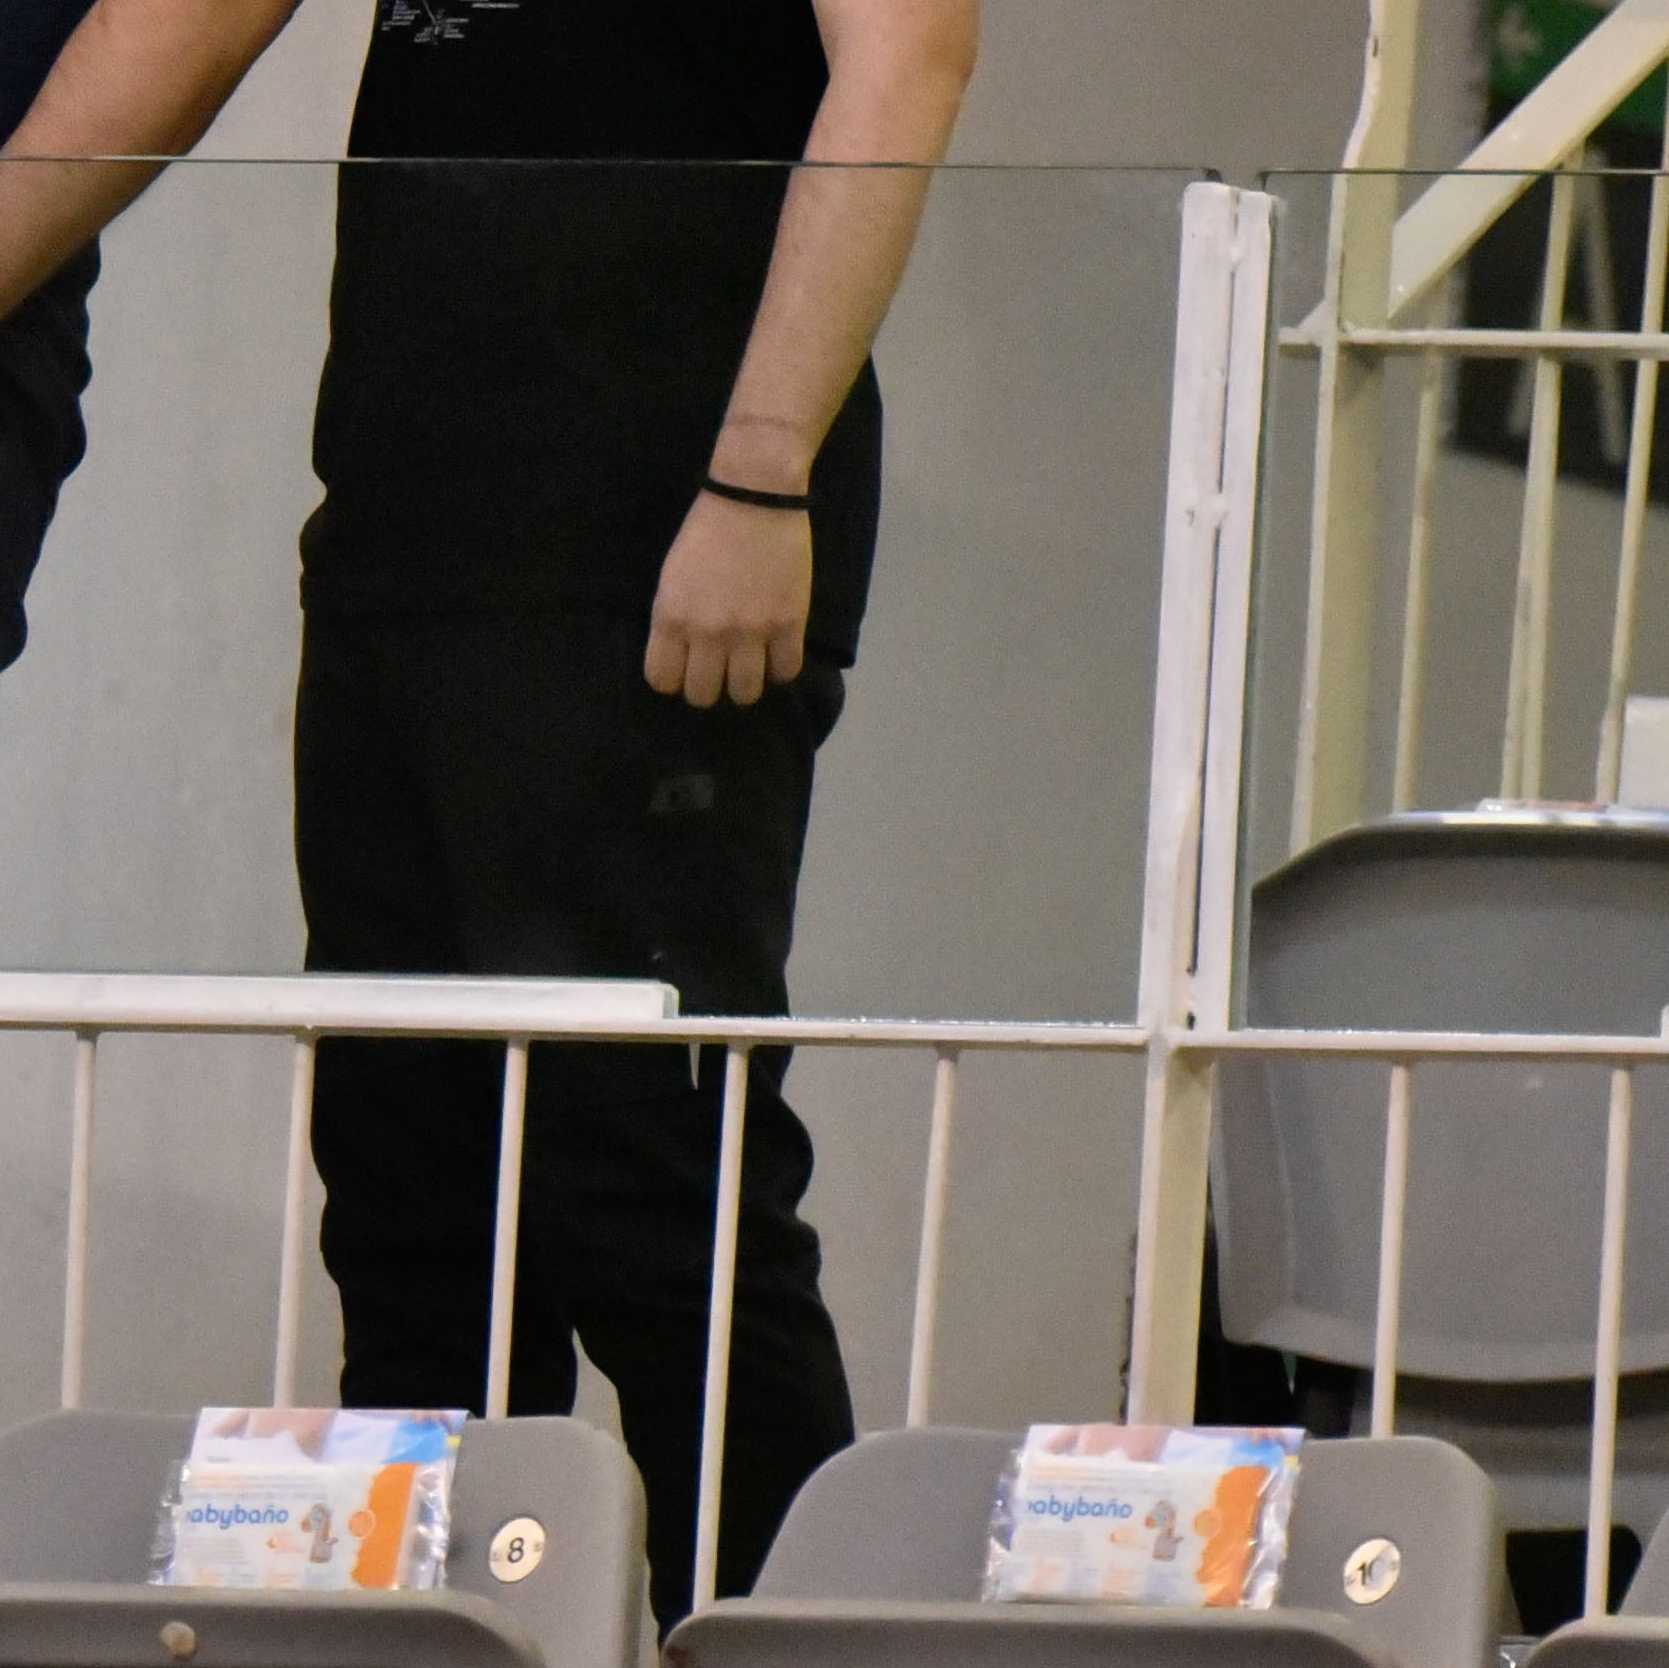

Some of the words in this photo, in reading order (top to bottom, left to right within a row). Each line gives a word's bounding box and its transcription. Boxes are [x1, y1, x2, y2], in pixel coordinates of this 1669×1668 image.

[186, 1503, 289, 1530] abybaño
[1028, 1494, 1133, 1523] abybaño
[506, 1536, 526, 1564] 8
